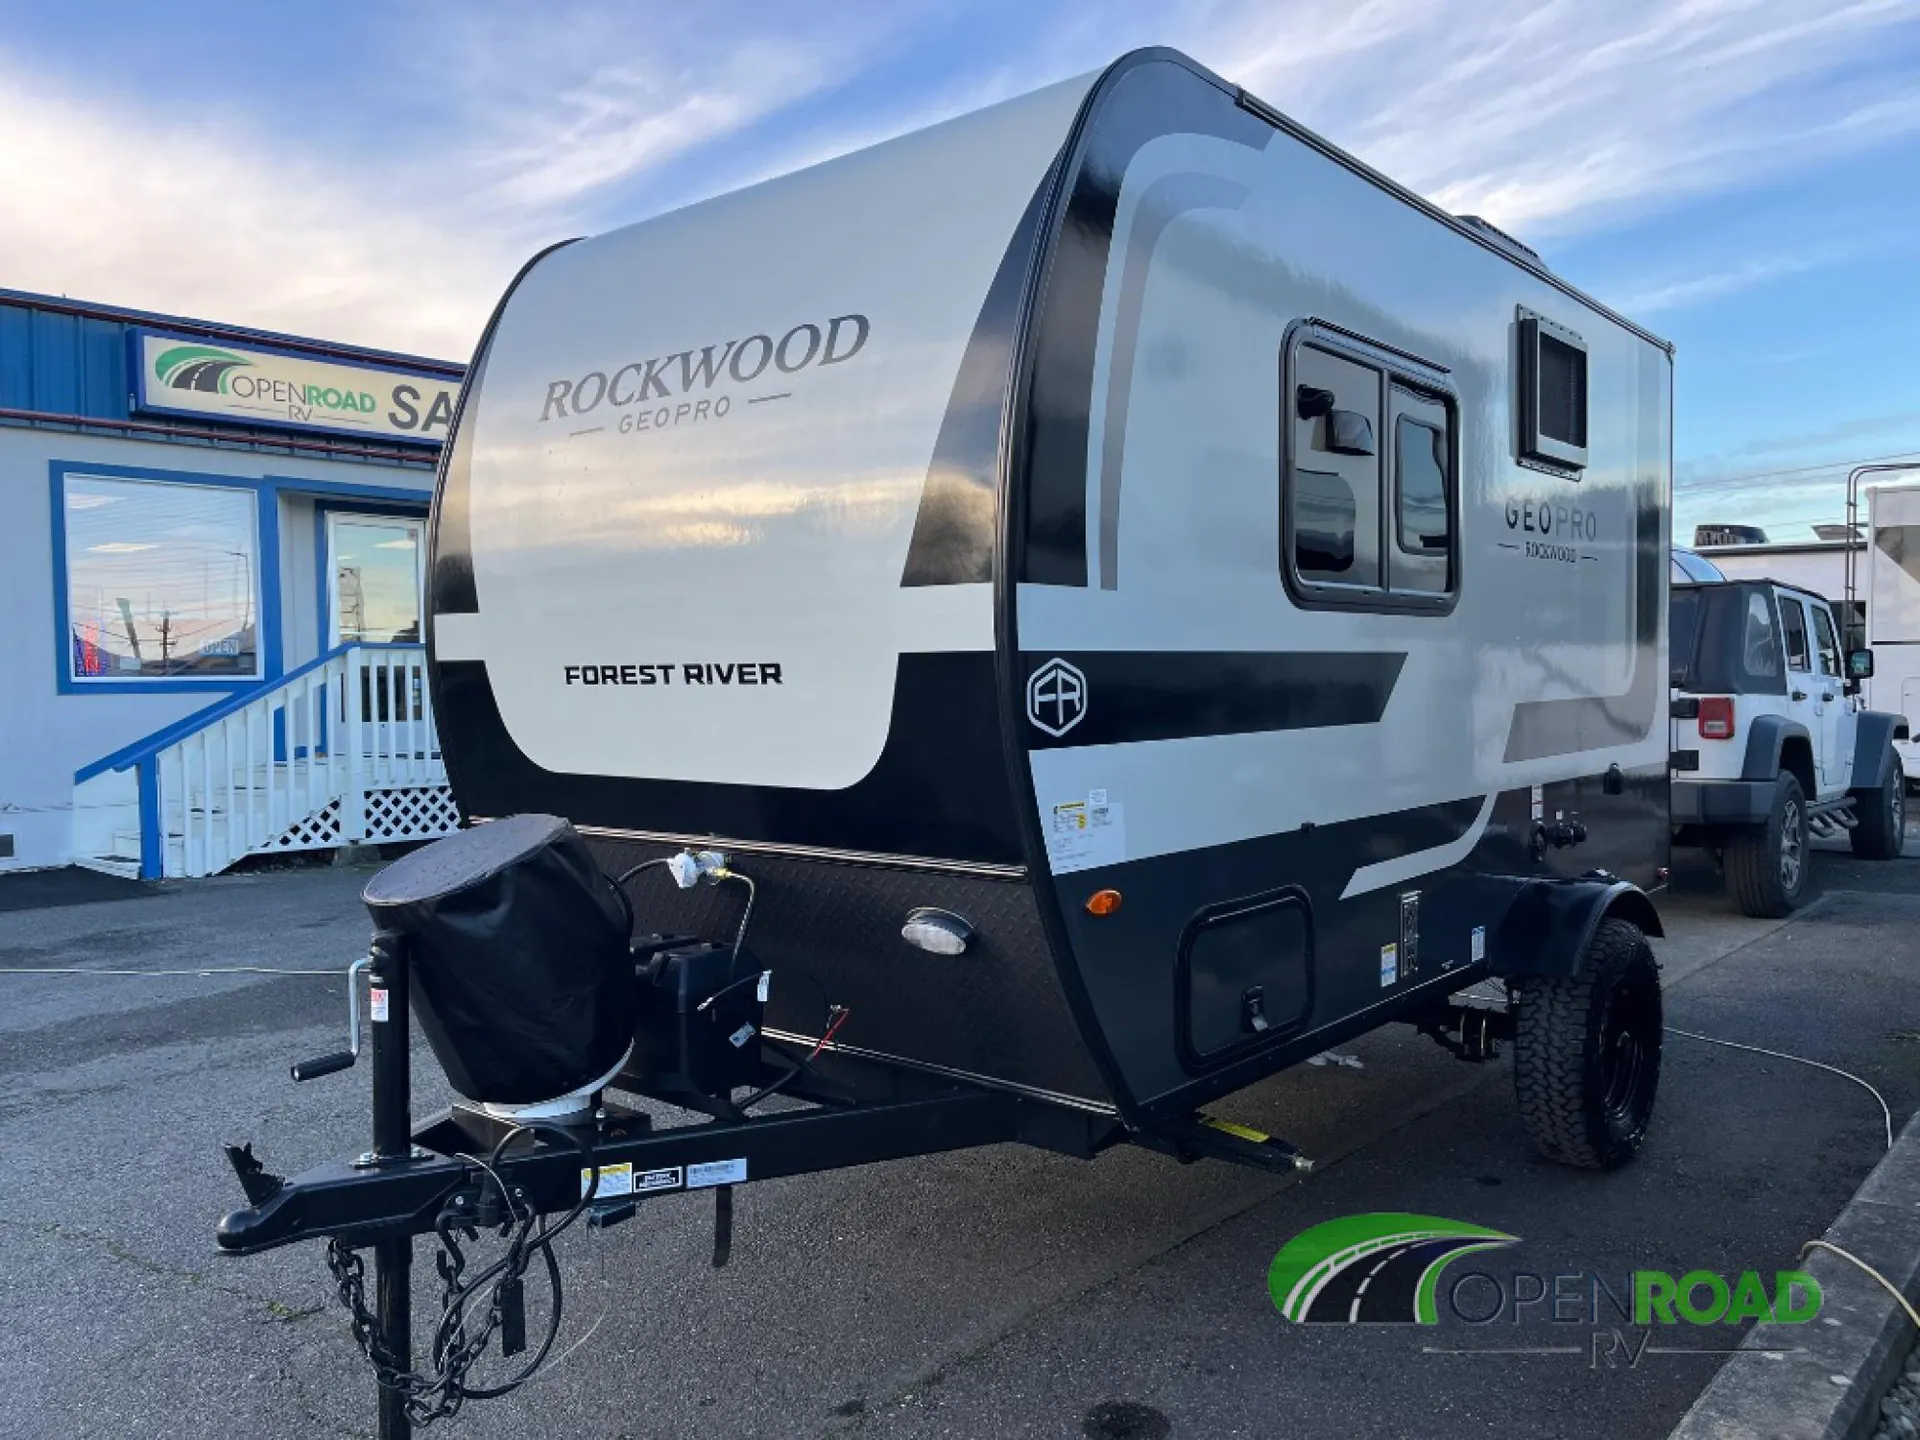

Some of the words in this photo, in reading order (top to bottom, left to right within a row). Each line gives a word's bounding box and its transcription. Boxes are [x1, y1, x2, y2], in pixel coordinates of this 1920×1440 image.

[538, 313, 871, 422] ROCKWOOD
[288, 404, 312, 421] RV
[618, 395, 731, 434] GEOPRO
[1505, 498, 1597, 542] GEOPRO
[564, 665, 676, 685] FOREST
[683, 663, 783, 685] RIVER
